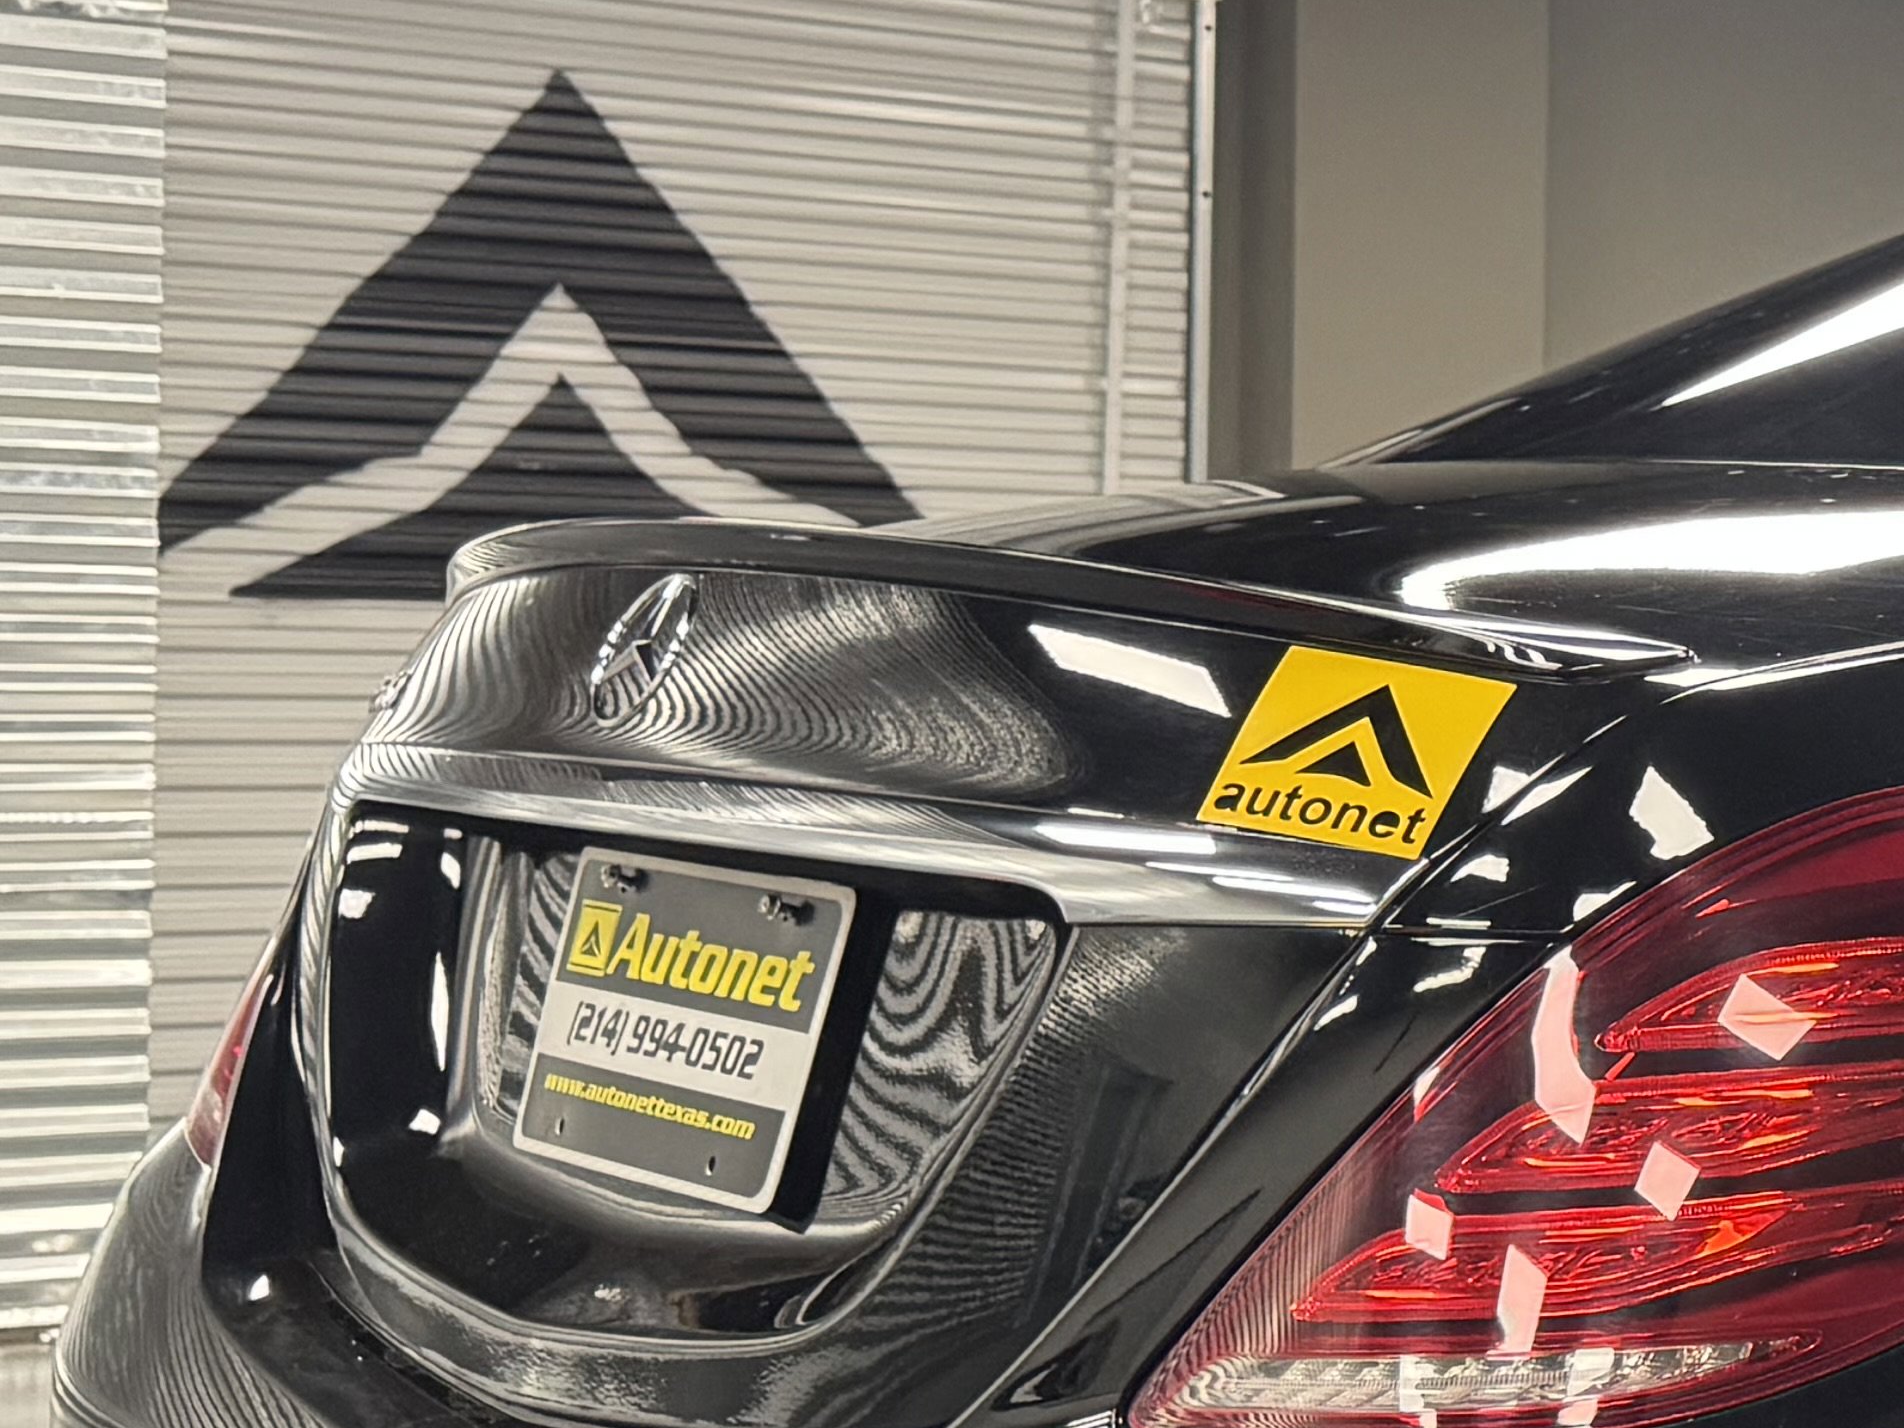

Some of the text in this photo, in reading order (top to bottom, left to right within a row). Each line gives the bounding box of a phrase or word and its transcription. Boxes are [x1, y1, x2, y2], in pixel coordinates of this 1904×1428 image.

[1213, 782, 1427, 845] autonet
[606, 913, 815, 1012] Autonet
[566, 1000, 765, 1080] (214) 994-0502
[544, 1074, 756, 1140] www.autonettexas.com
